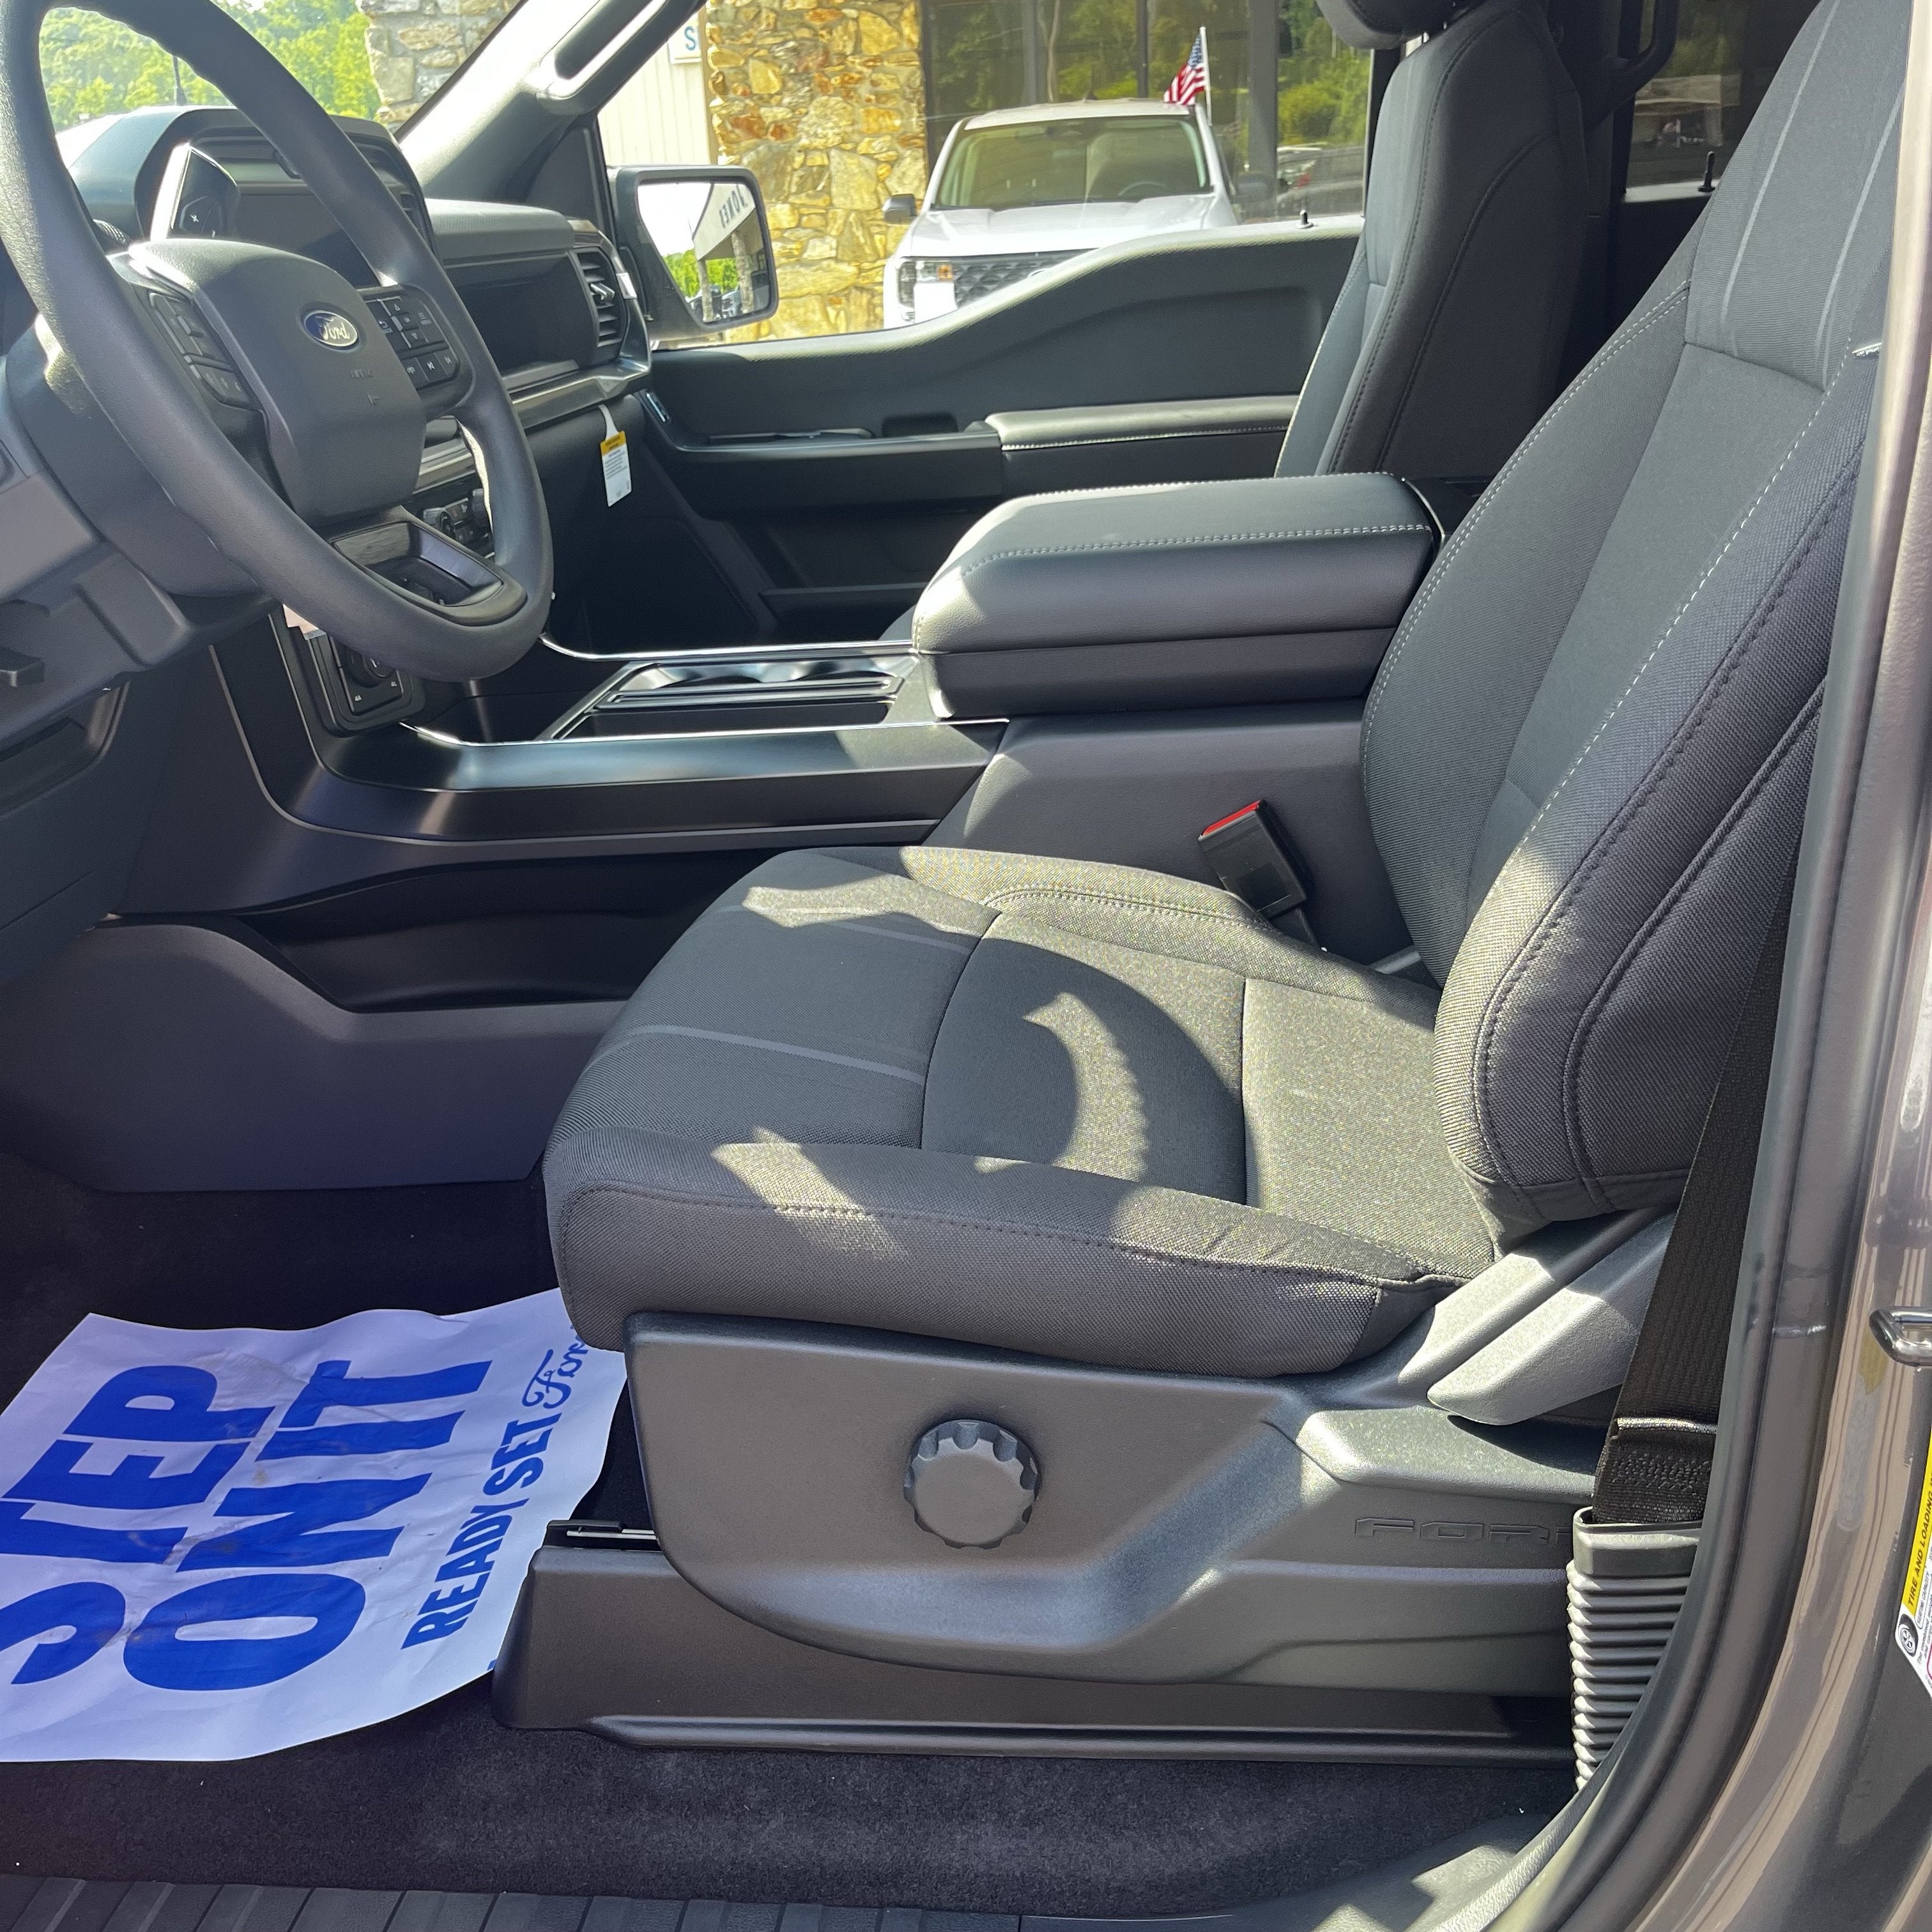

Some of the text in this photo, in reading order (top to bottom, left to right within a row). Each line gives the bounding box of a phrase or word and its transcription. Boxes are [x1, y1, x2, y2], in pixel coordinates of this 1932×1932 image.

[314, 315, 350, 341] Ford
[0, 1365, 276, 1685] STEP
[401, 1324, 589, 1650] READY SET For
[1354, 1516, 1574, 1545] FOR
[1908, 1491, 1932, 1607] TIRE AND LOADING
